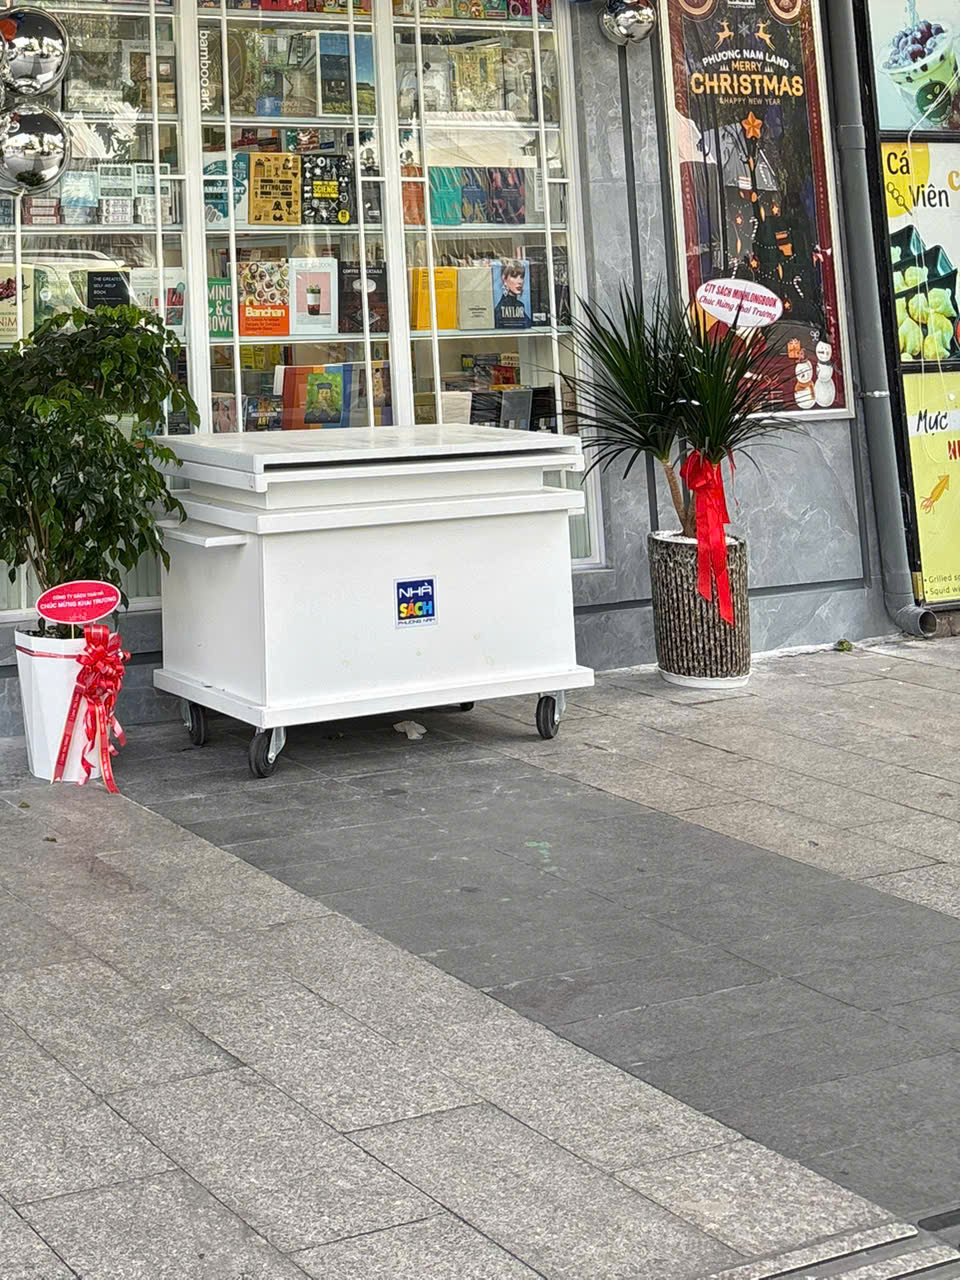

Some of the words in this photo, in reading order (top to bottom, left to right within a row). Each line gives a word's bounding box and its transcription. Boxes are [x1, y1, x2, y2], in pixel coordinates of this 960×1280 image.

[731, 60, 763, 72] MERRY
[742, 48, 764, 60] NAM
[764, 52, 790, 69] LAND
[690, 71, 804, 97] CHRISTMAS
[886, 150, 911, 175] Cá
[313, 185, 339, 193] SCIENCE
[908, 184, 950, 208] Viên
[245, 306, 286, 317] Banchan
[500, 306, 525, 318] TAYLOR
[916, 408, 949, 436] Mực
[399, 582, 433, 599] NHÀ
[399, 598, 433, 618] SÁCH
